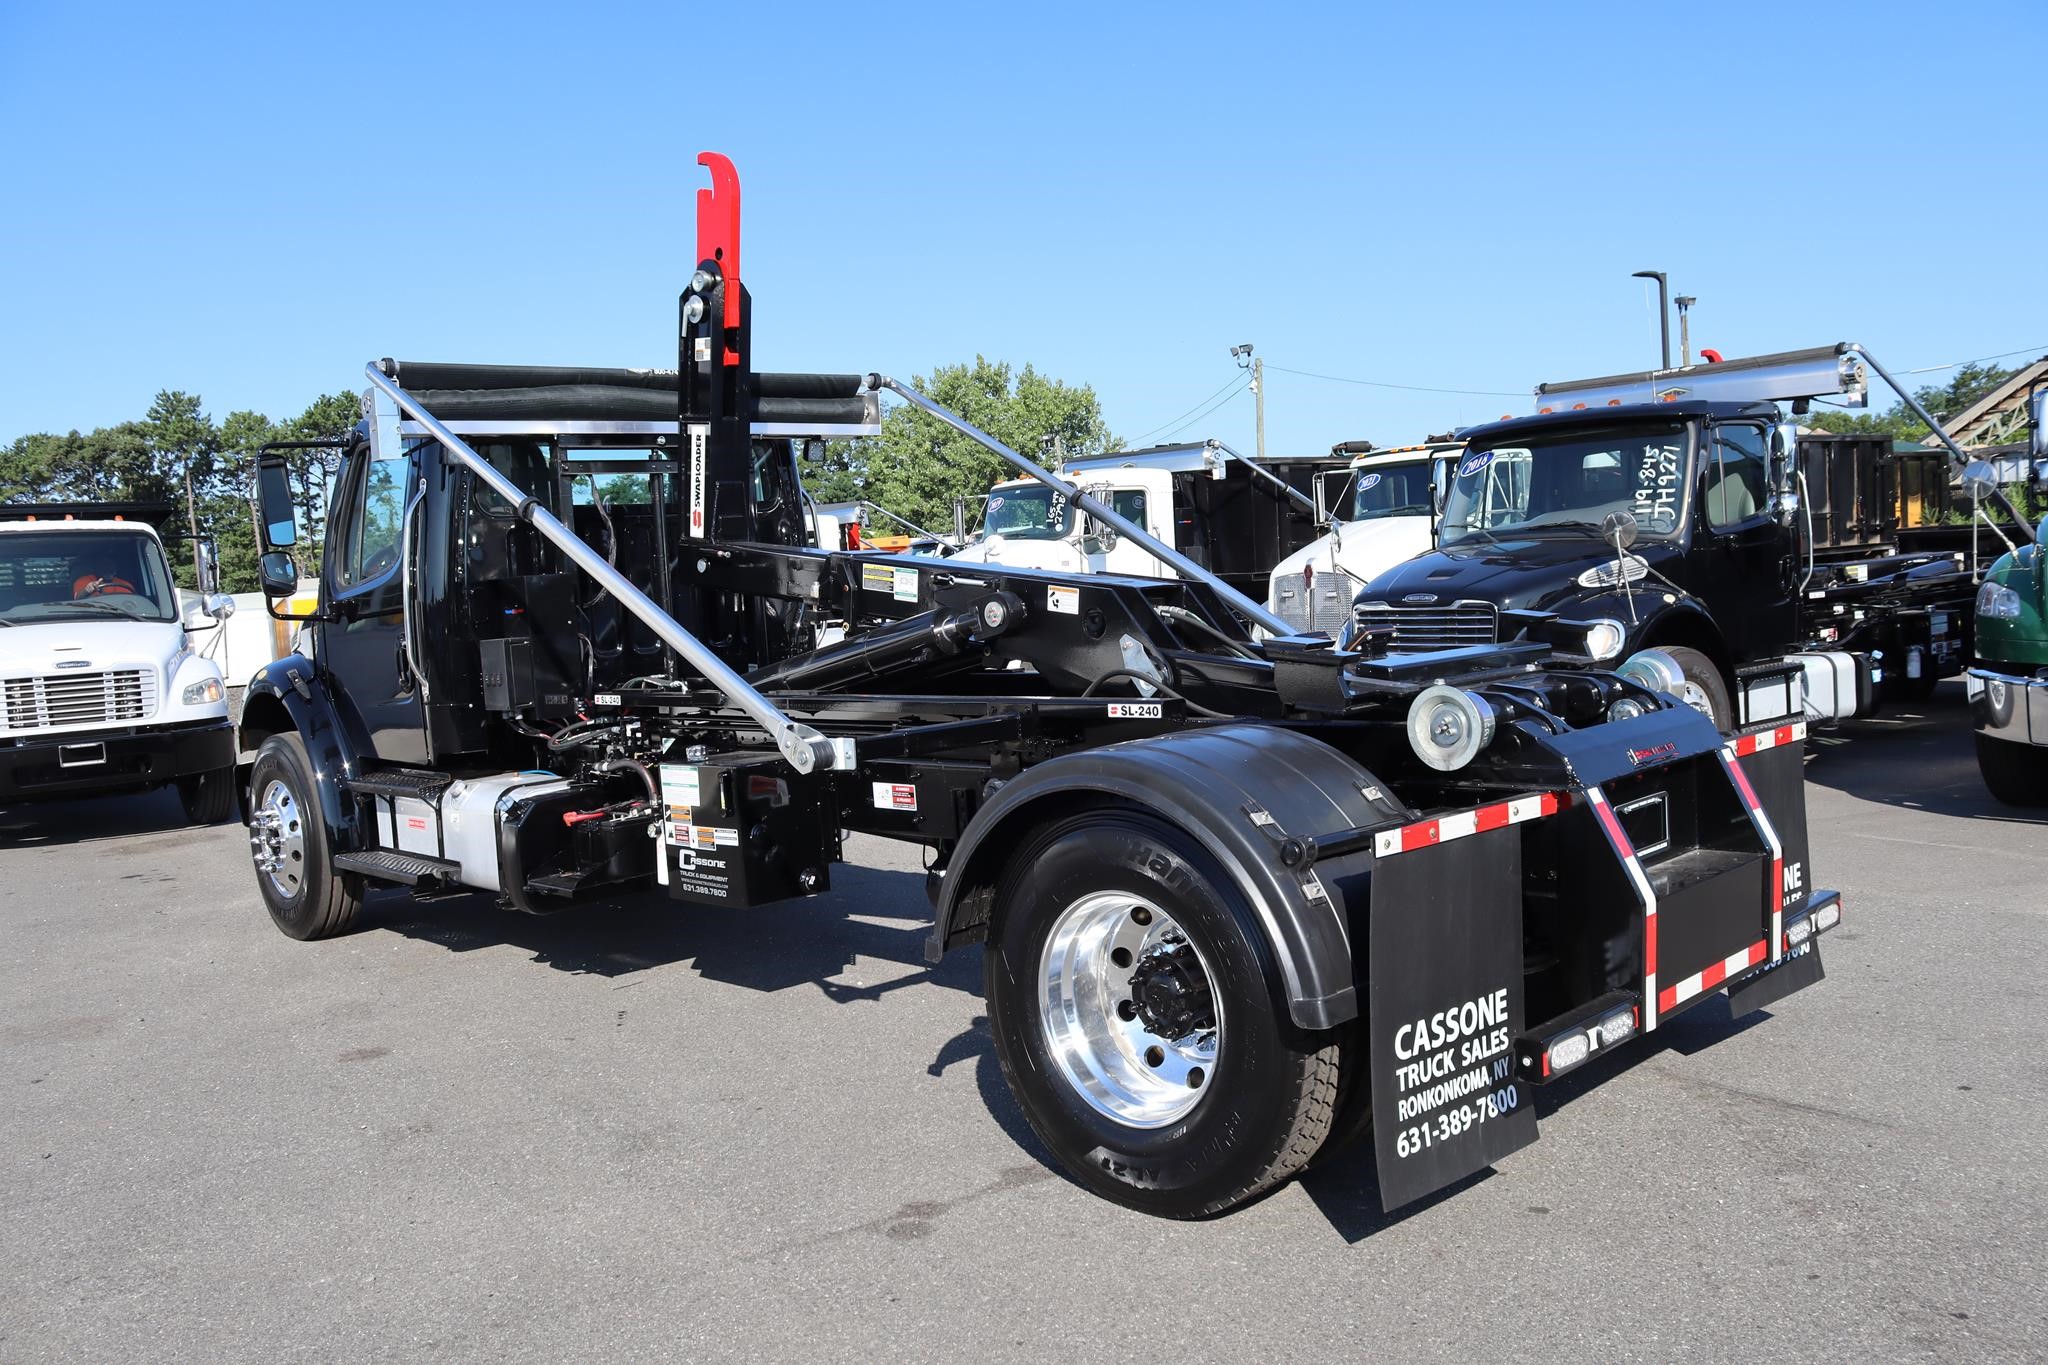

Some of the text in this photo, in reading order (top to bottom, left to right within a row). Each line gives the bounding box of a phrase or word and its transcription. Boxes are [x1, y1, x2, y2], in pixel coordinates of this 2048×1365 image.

[1464, 453, 1489, 475] 2018
[1654, 445, 1680, 520] JH9271
[1121, 705, 1159, 717] SL-240
[679, 848, 727, 870] CASSONE
[680, 870, 695, 878] TRUCK
[700, 873, 729, 883] EQUIPMENT
[683, 883, 727, 898] 631.389.7800
[1394, 988, 1508, 1060] CASSONE
[1396, 1027, 1509, 1092] TRUCK SALES
[1398, 1055, 1509, 1122] RONKONKOMA, NY
[1396, 1084, 1518, 1158] 631-389-7800
